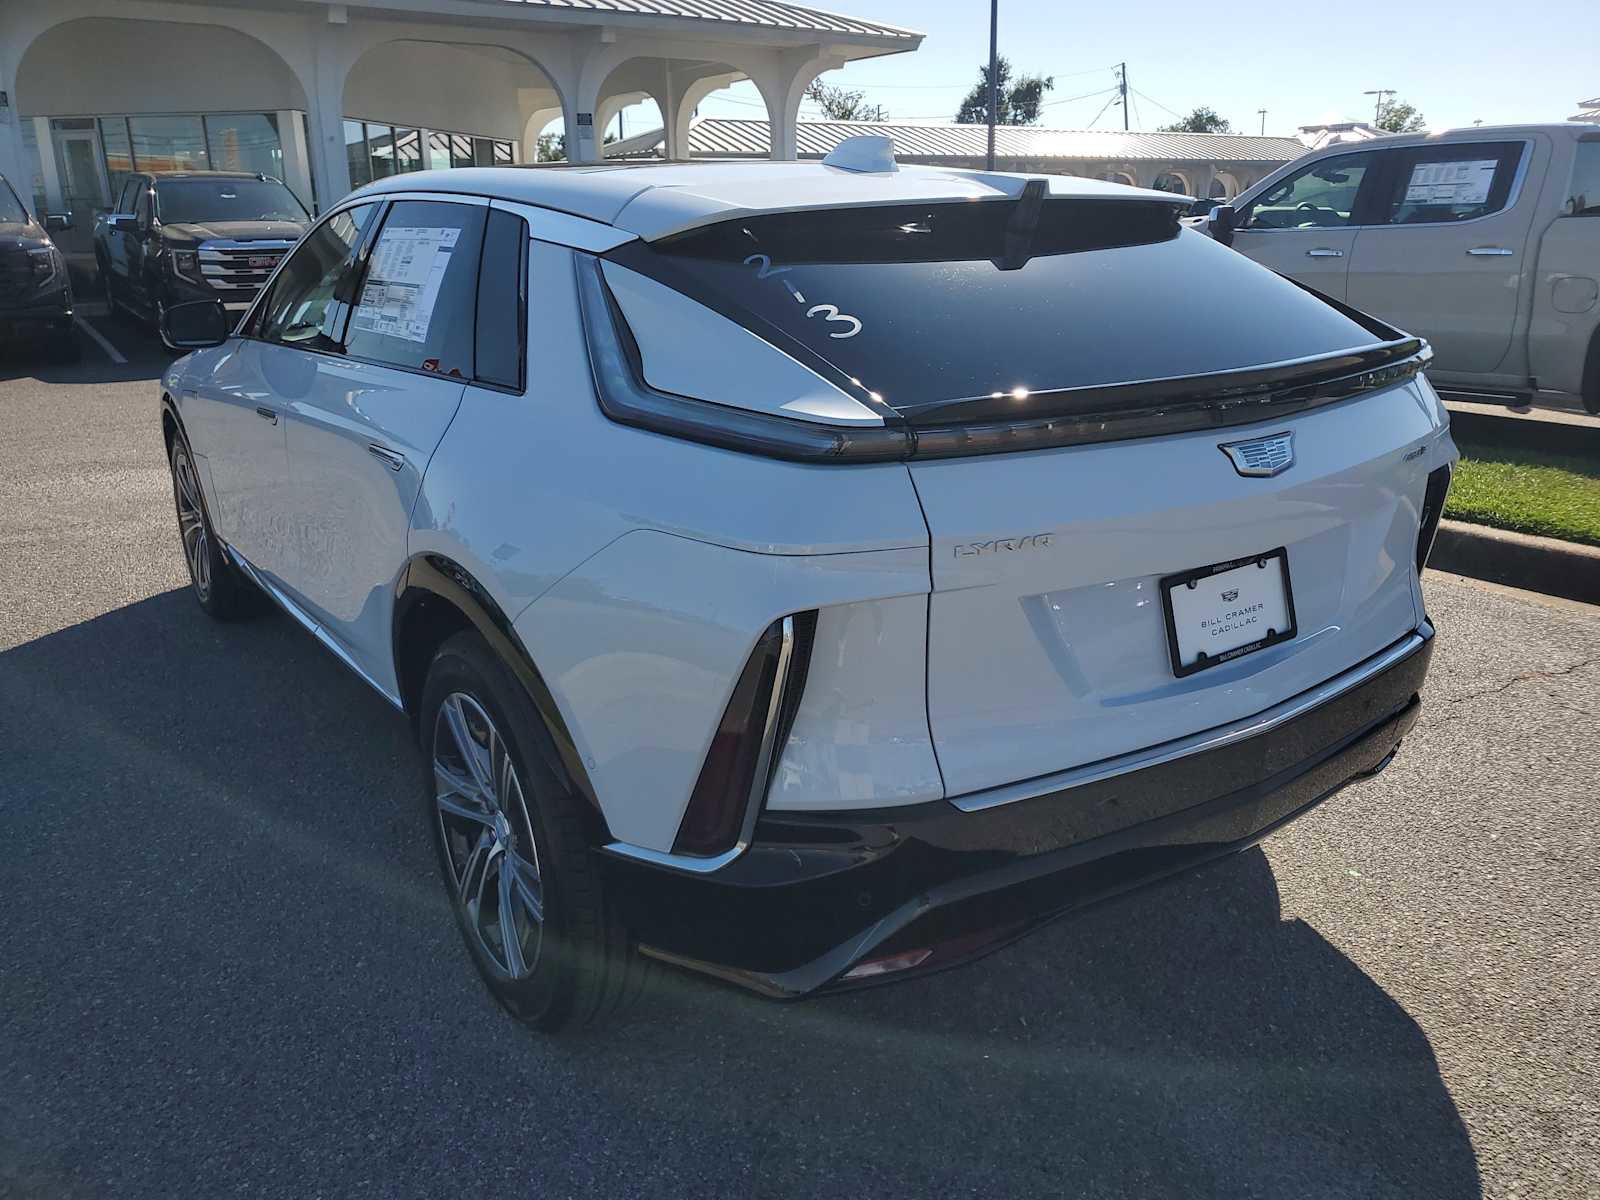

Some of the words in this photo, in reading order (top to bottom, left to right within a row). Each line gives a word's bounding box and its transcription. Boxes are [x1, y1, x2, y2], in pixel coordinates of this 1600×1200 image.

[1201, 617, 1222, 628] BILL
[1225, 603, 1264, 621] CRAMER
[1211, 616, 1257, 636] CADILLAC
